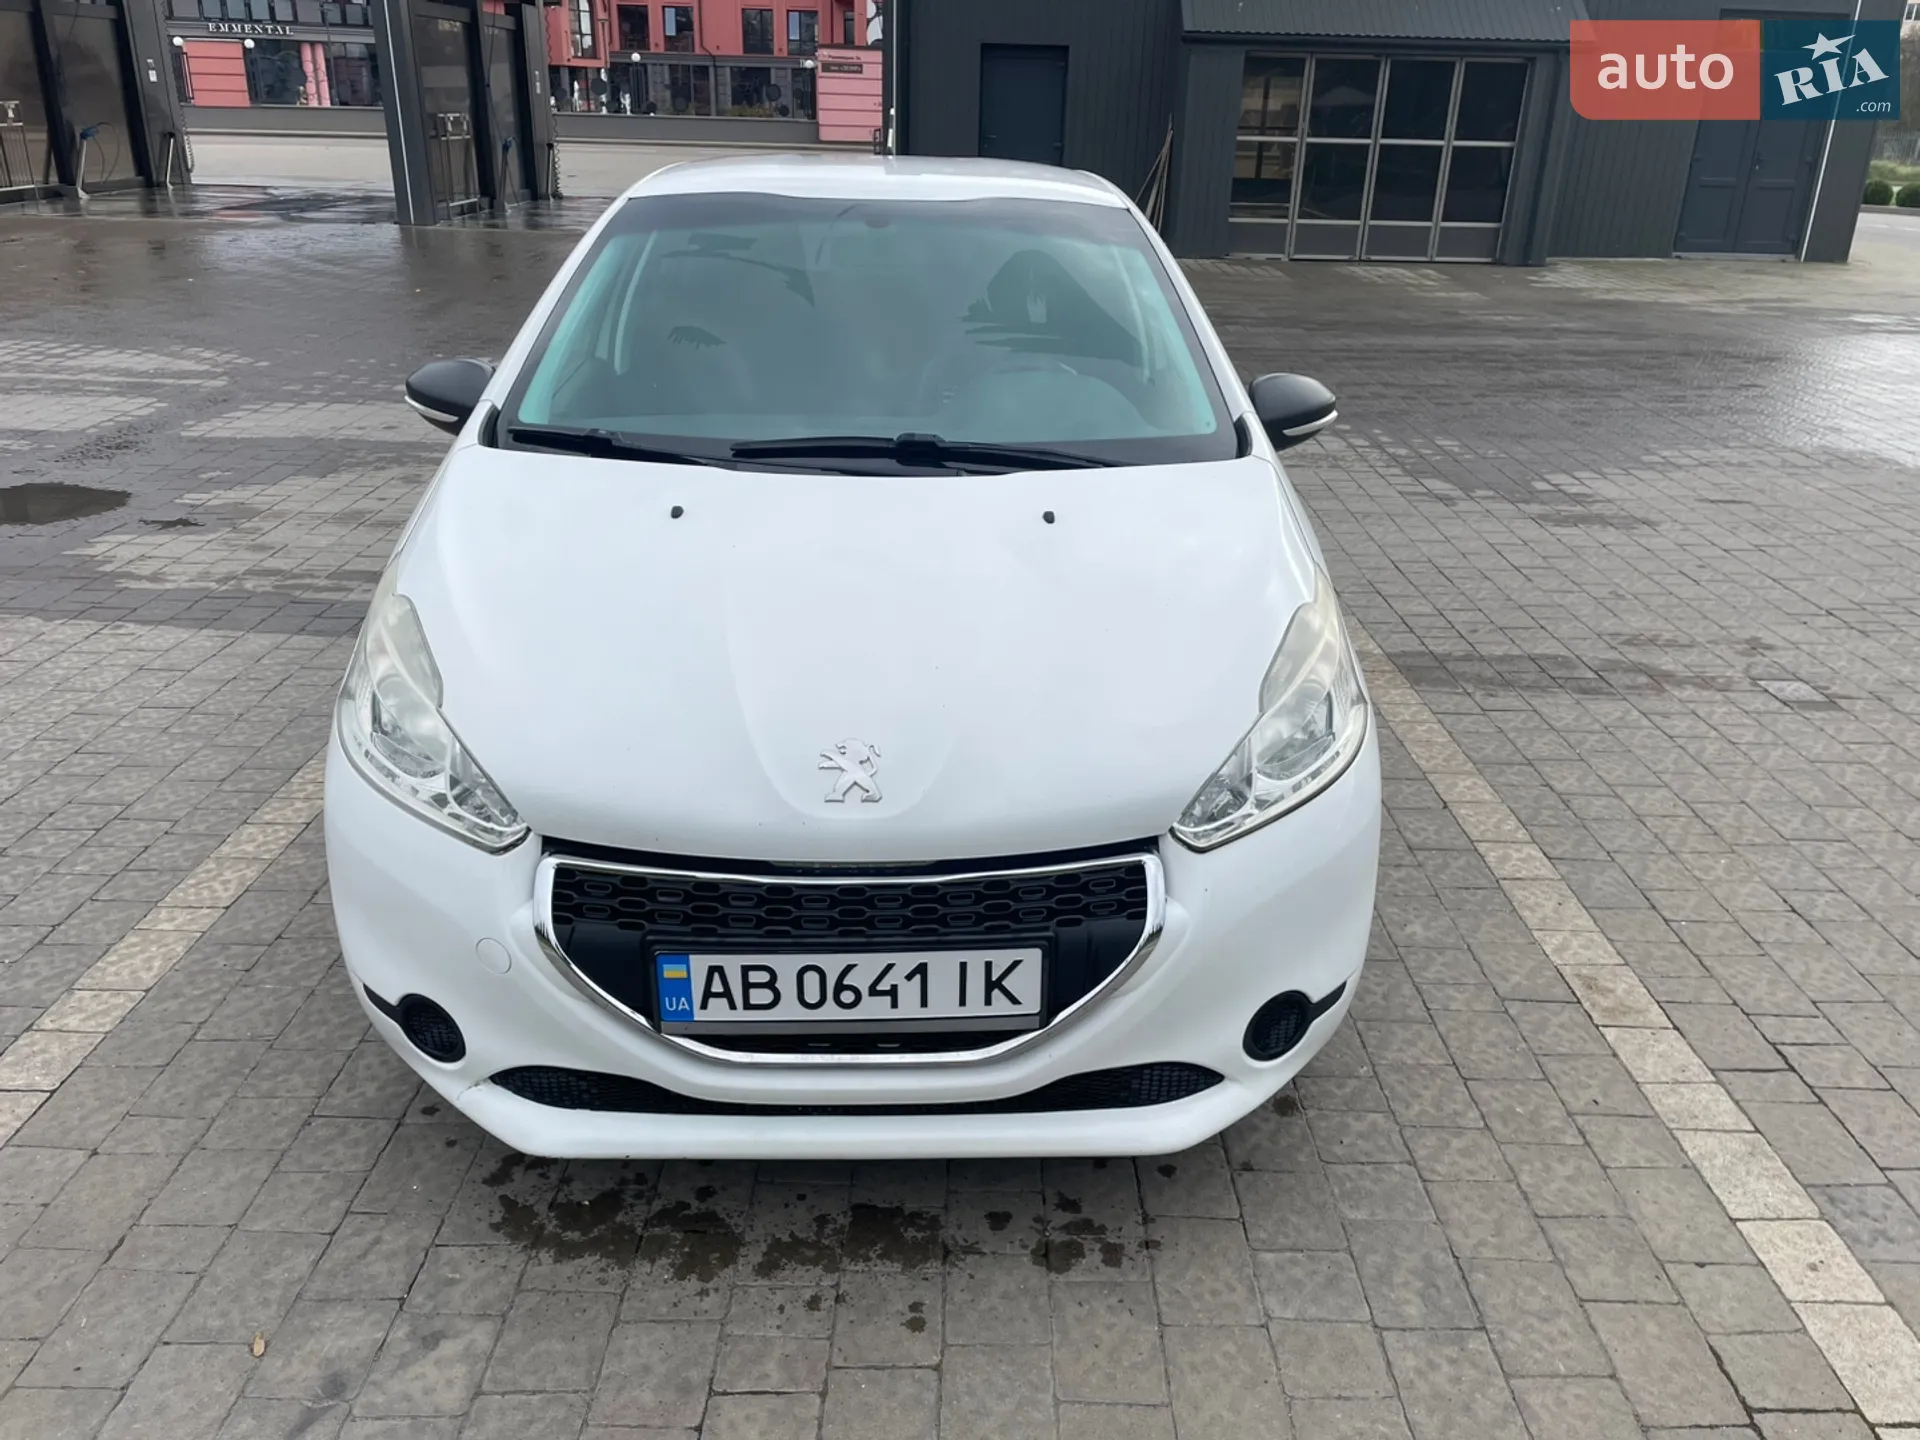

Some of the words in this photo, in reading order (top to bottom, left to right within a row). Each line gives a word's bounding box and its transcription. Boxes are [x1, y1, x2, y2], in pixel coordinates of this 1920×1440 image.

[208, 22, 294, 35] EMMENTAL
[699, 963, 782, 1011] AB
[795, 961, 929, 1011] 0641
[958, 958, 1025, 1008] IK
[665, 996, 690, 1012] UA
